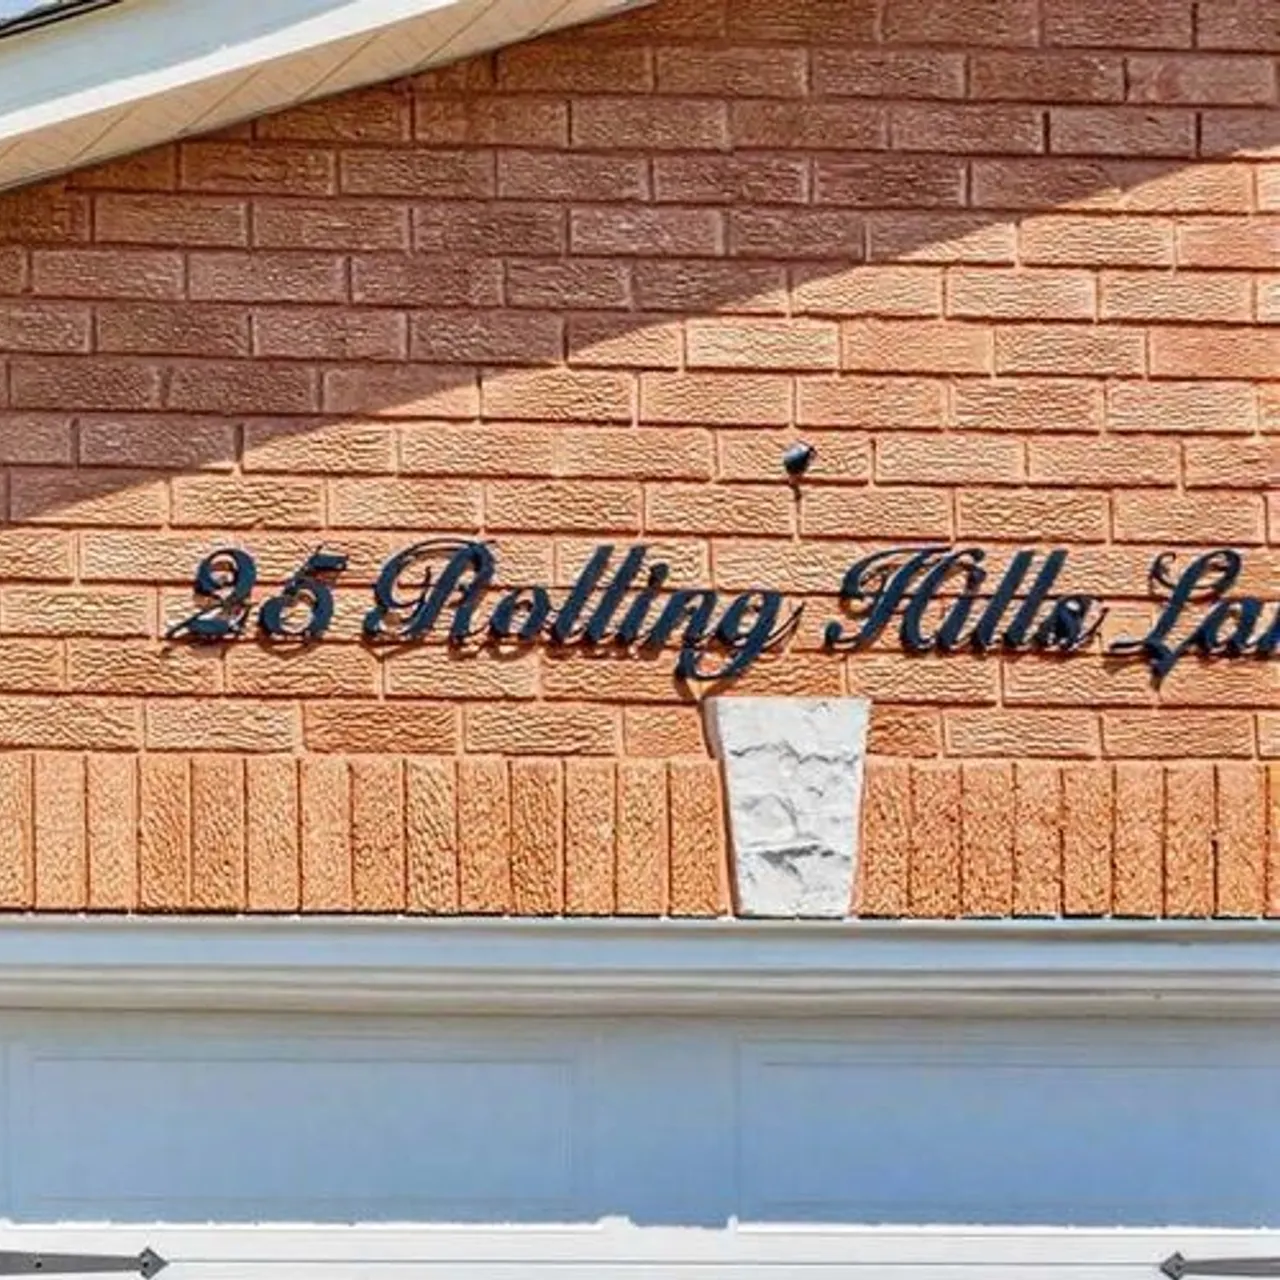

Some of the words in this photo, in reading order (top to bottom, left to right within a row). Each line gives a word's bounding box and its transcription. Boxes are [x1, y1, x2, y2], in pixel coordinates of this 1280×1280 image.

[165, 546, 348, 642] 25
[362, 537, 805, 681] Rolling
[824, 545, 1109, 653] Hills
